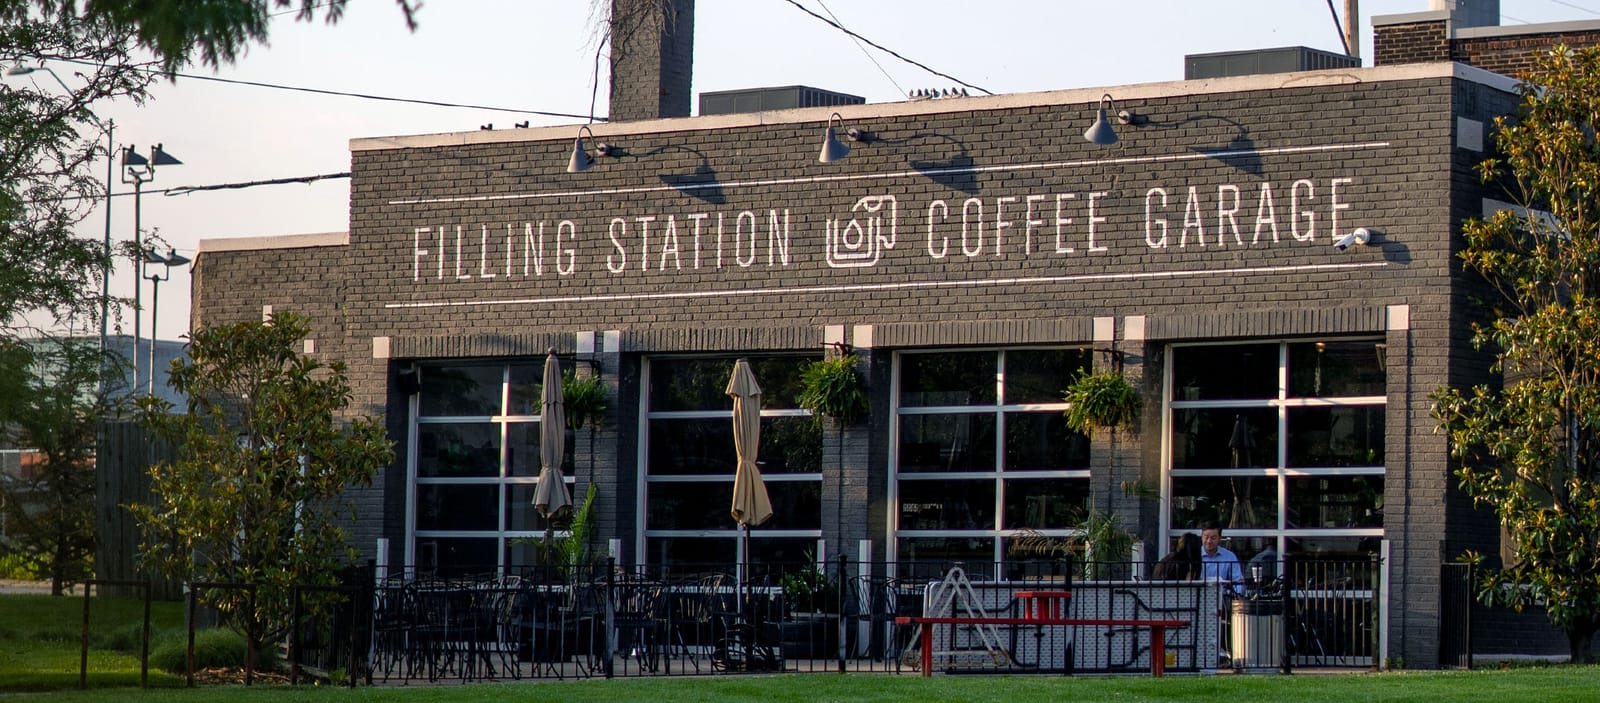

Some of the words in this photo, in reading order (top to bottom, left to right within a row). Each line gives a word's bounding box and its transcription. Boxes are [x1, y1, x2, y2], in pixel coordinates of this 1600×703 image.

[414, 219, 576, 281] FILLING
[606, 208, 790, 273] STATION
[928, 191, 1108, 258] COFFEE
[1144, 177, 1353, 249] GARAGE
